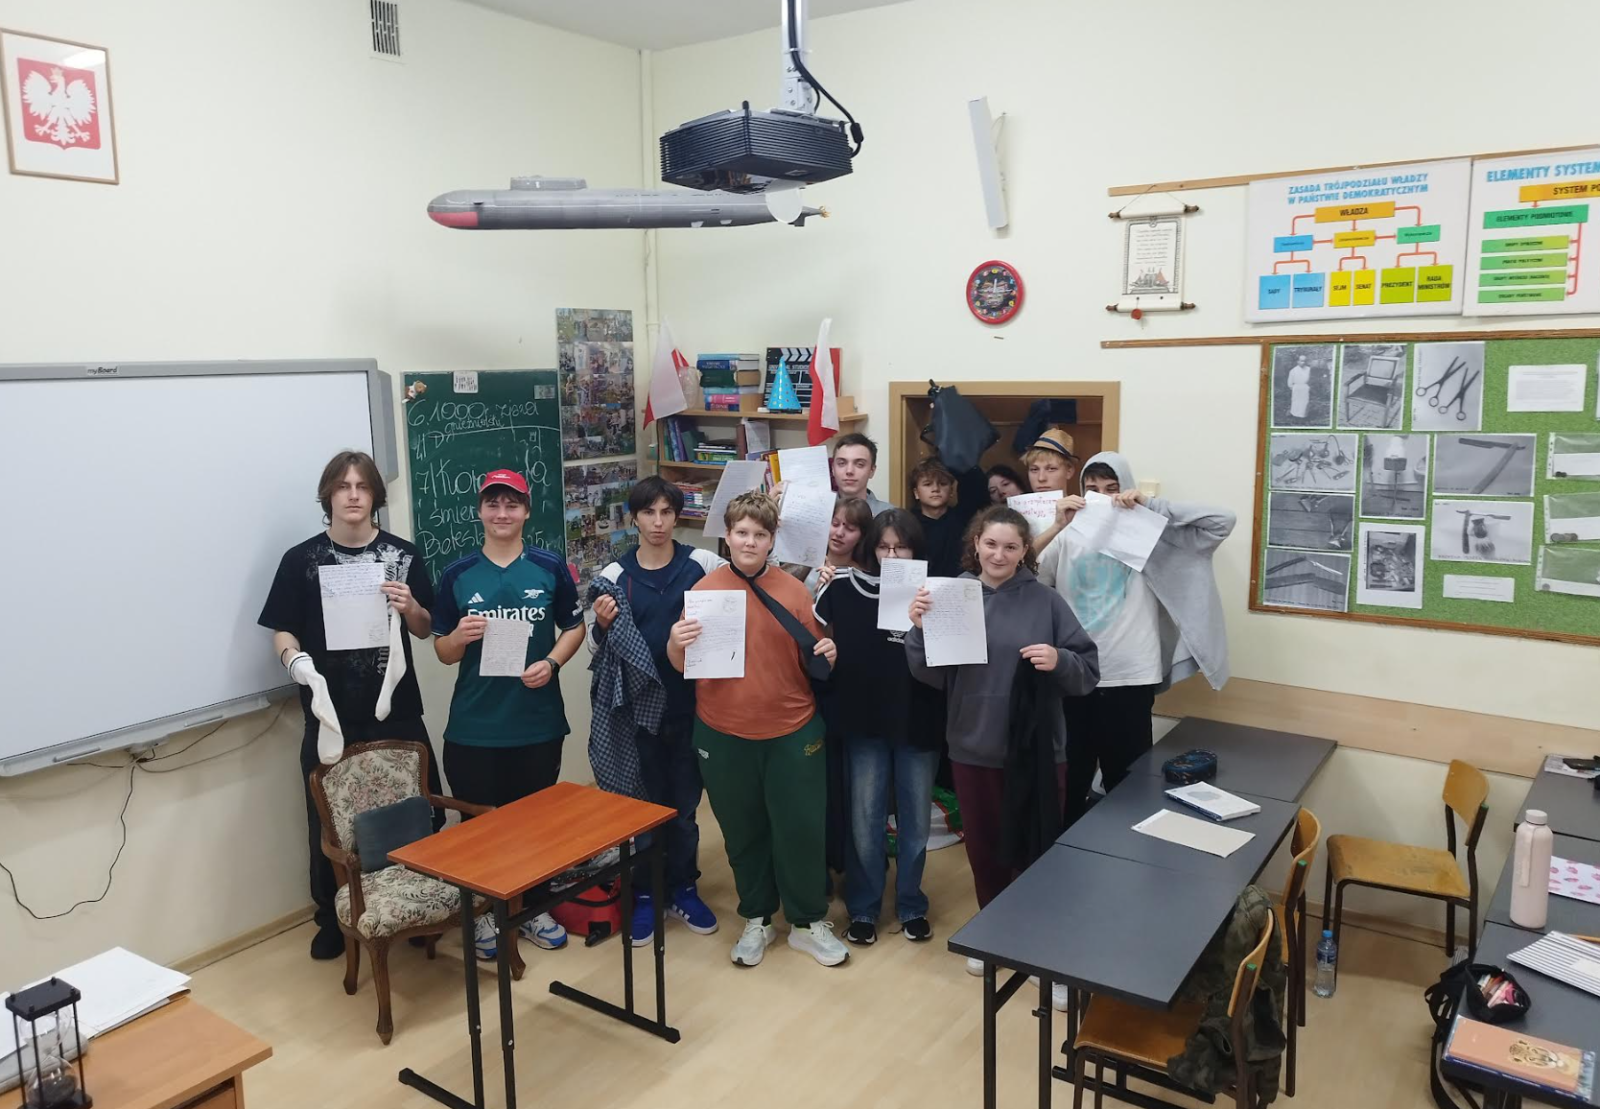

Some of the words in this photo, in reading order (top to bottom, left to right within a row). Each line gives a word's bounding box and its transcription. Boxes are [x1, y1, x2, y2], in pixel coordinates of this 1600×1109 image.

[1487, 166, 1550, 182] ELEMENTY
[1288, 184, 1321, 195] ZASADA
[1324, 177, 1388, 192] TRÓJPODZIAŁU
[1391, 173, 1429, 185] WŁADZY
[1553, 185, 1588, 195] SYSTEM
[1287, 196, 1296, 205] W
[1298, 191, 1340, 204] PAŃSTWIE
[1343, 184, 1429, 200] DEMOKRATYCZNYM
[1339, 207, 1369, 217] WŁADZA
[1496, 214, 1528, 223] ELEMENTY
